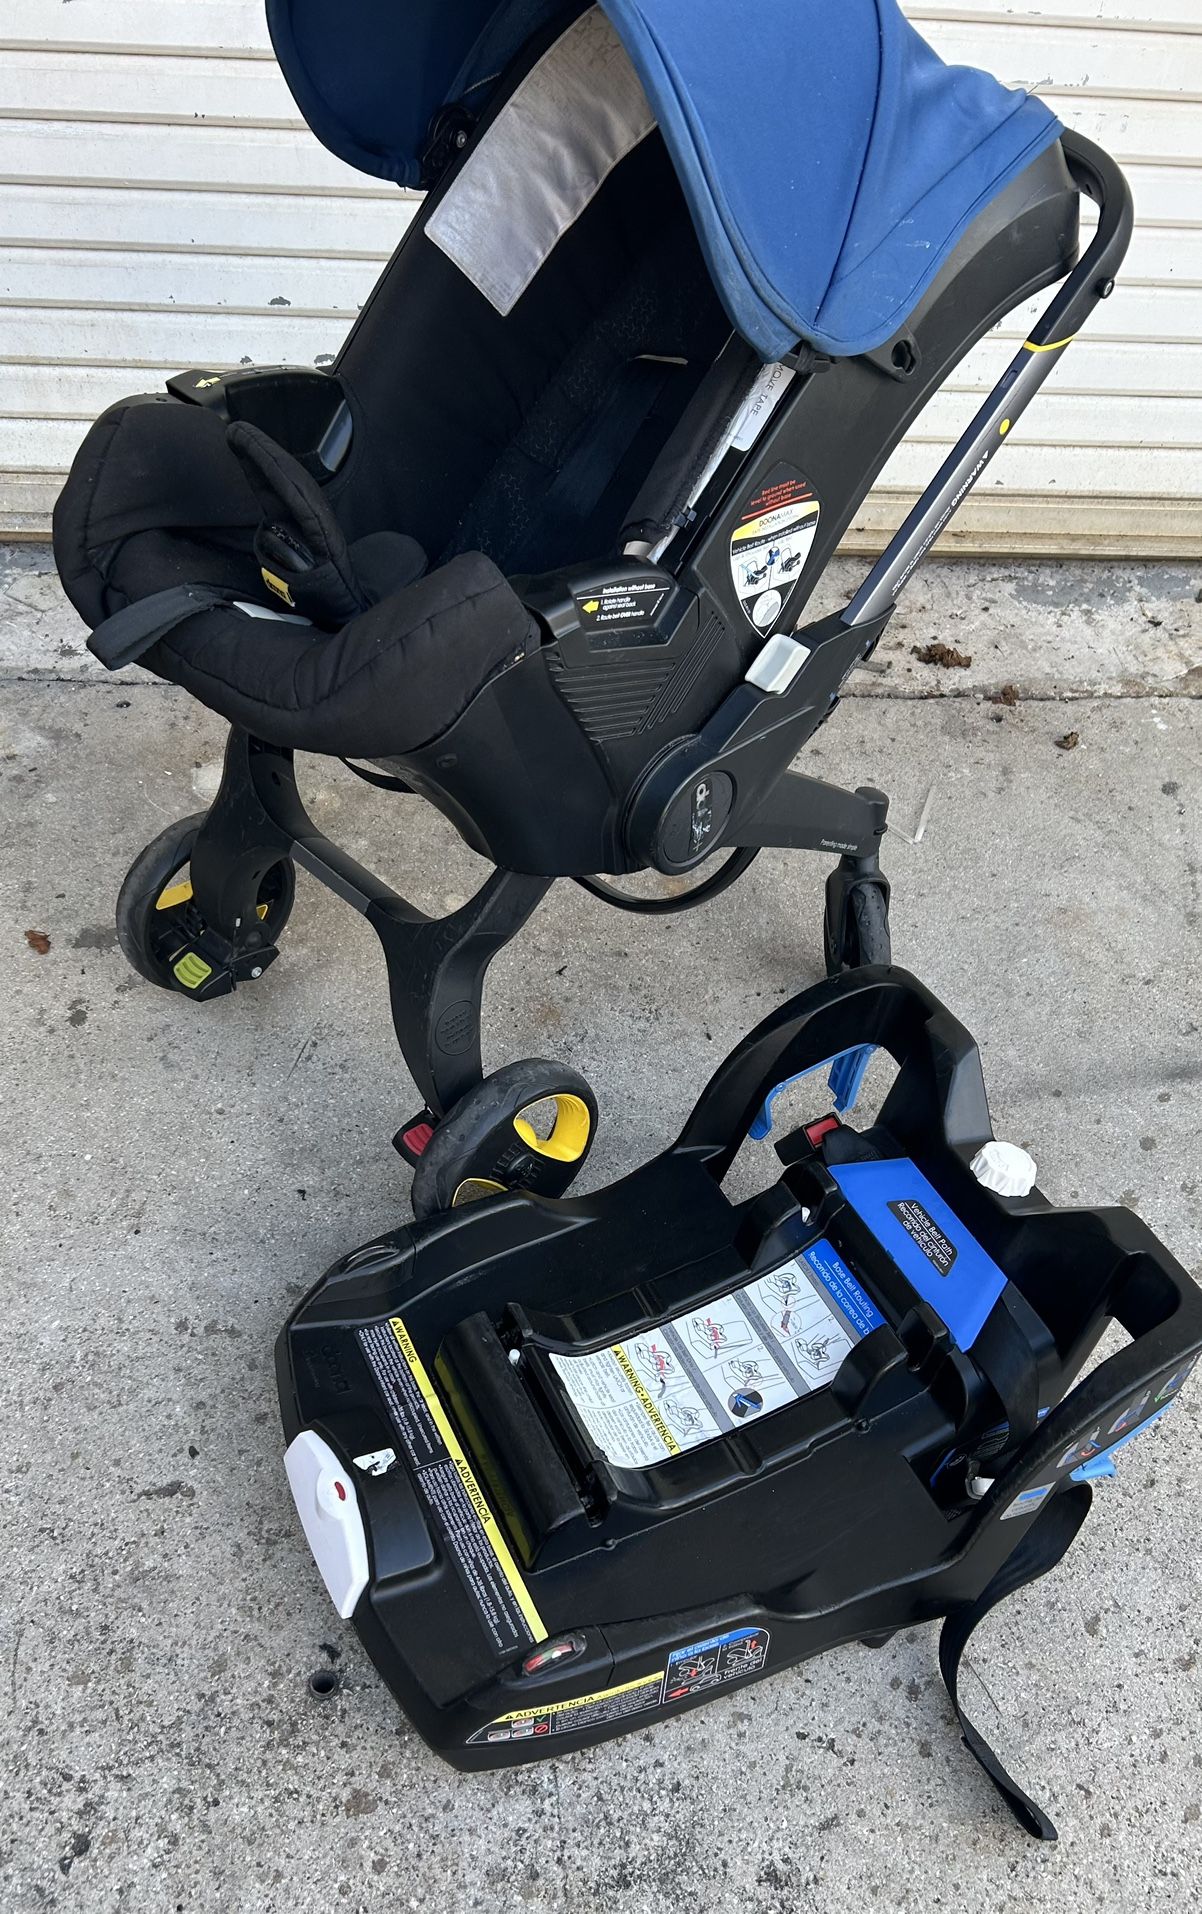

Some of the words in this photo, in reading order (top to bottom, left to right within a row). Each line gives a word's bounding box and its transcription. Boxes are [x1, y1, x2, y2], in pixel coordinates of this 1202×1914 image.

[749, 392, 768, 416] TAPE
[949, 459, 984, 508] WARNING
[896, 1201, 922, 1232] Recorrido
[918, 1229, 931, 1242] del
[902, 1219, 912, 1230] de
[909, 1202, 932, 1228] Vehicle
[927, 1224, 942, 1240] Belt
[937, 1237, 954, 1256] Path
[806, 1250, 833, 1282] Recorrido
[827, 1279, 840, 1292] de
[834, 1288, 844, 1298] la
[839, 1295, 860, 1320] correa
[855, 1316, 867, 1329] de
[831, 1261, 847, 1279] Base
[842, 1276, 856, 1292] Belt
[850, 1289, 875, 1318] Routing
[394, 1325, 417, 1363] WARNING
[615, 1355, 644, 1393] WARNING
[640, 1397, 677, 1450] ADVERTENCIA
[458, 1464, 492, 1523] ADVERTENCIA
[515, 1696, 594, 1719] ADVERTENCIA
